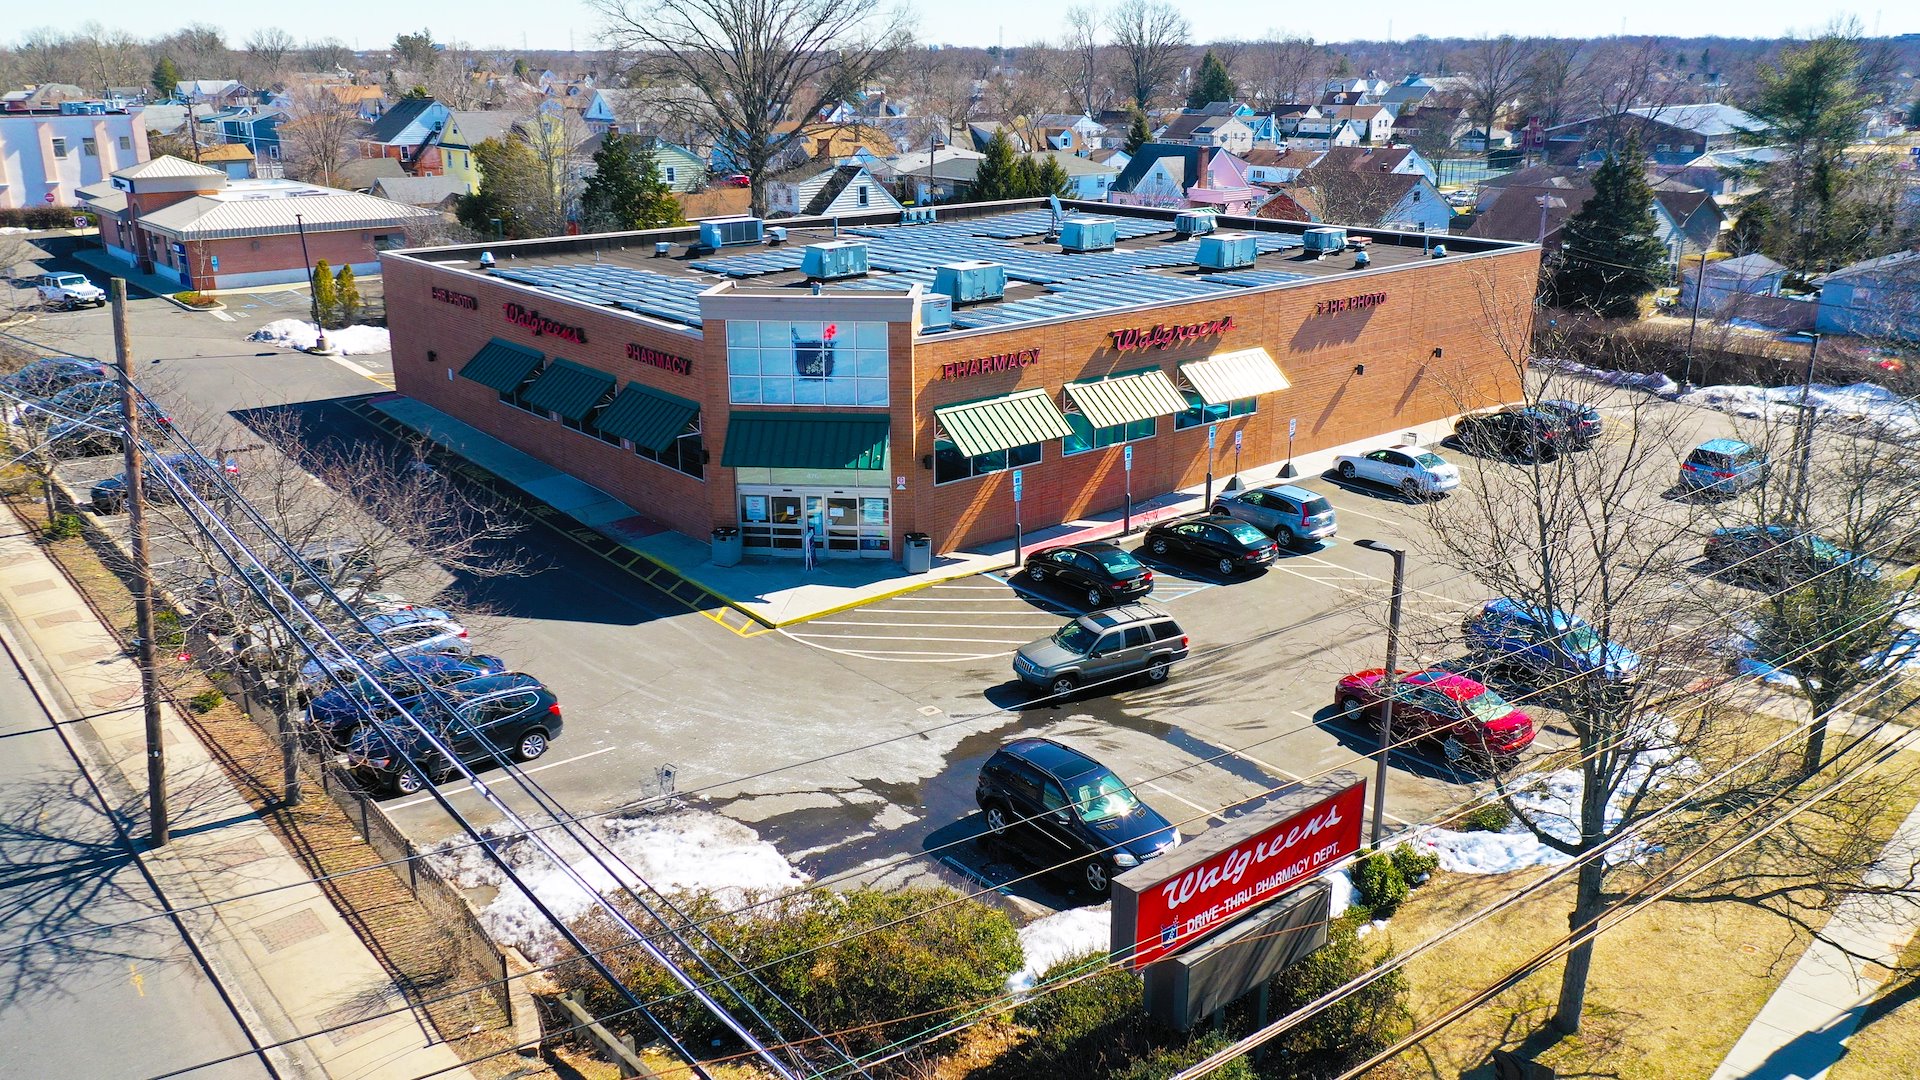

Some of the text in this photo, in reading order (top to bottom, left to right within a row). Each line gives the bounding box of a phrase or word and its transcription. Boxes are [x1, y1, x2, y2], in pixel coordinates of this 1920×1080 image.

[448, 291, 476, 310] PHOTO
[1350, 292, 1387, 310] PHOTO
[503, 303, 585, 344] Walgreens
[1112, 316, 1237, 351] Walgreens
[625, 343, 690, 375] PHARMACY
[943, 348, 1040, 380] PHARMACY
[1162, 805, 1343, 910] Walgreens
[1186, 842, 1340, 933] DRIVE-THRU PHARMACY DEPT.
